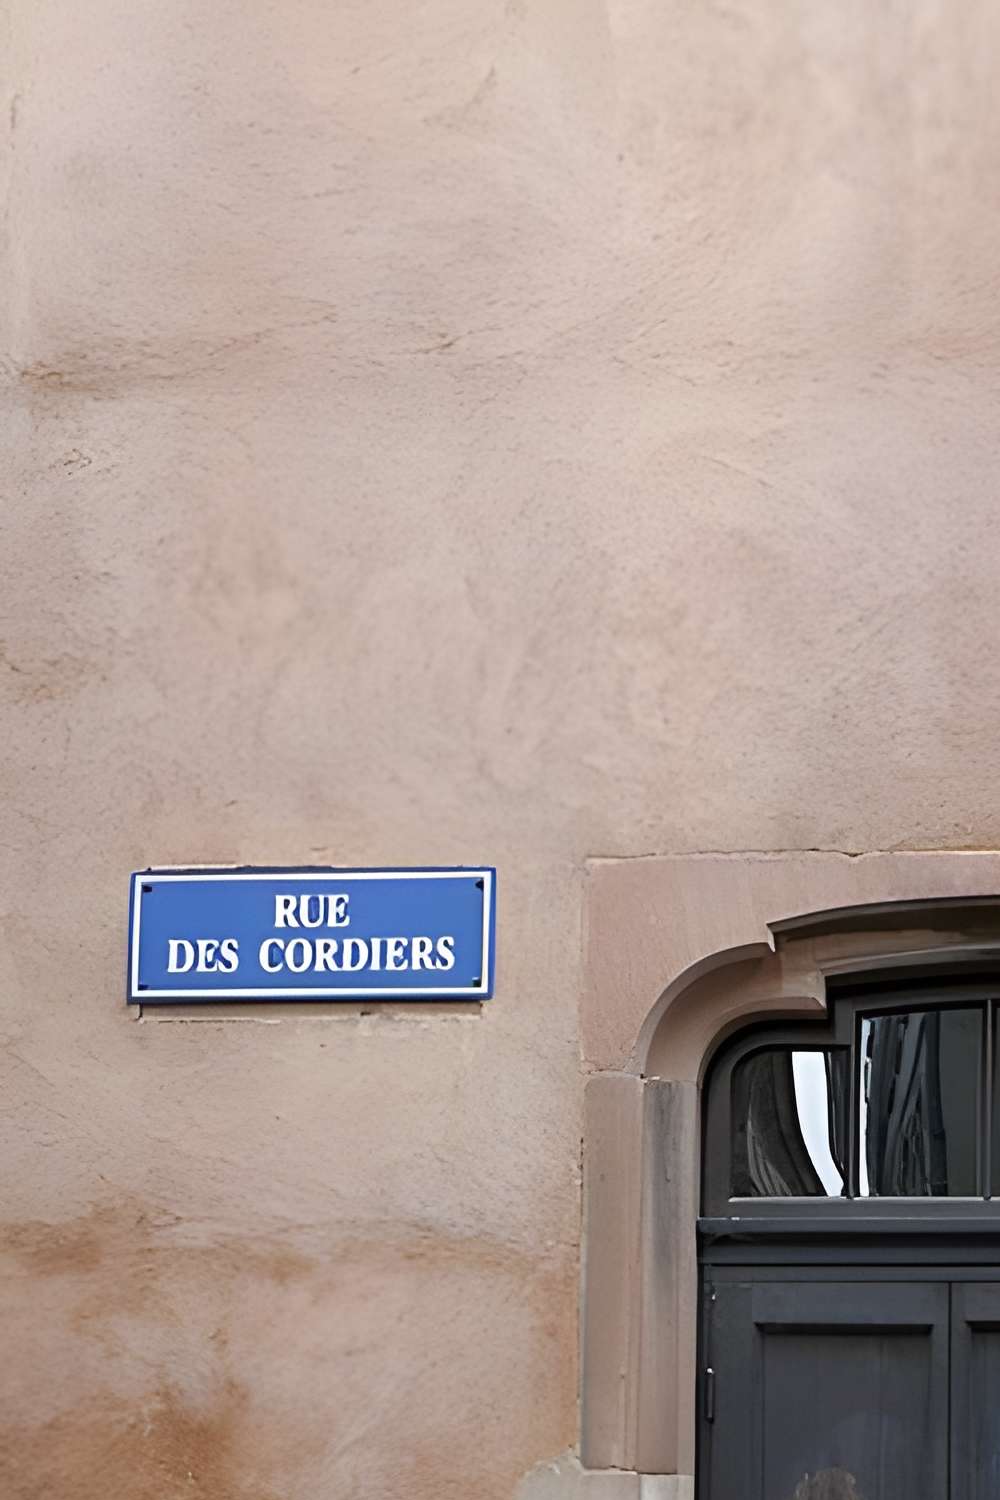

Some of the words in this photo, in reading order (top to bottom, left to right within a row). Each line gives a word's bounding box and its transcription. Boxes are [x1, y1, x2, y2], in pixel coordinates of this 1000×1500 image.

[274, 894, 350, 928] RUE
[167, 938, 239, 973] DES
[258, 936, 455, 973] CORDIERS
